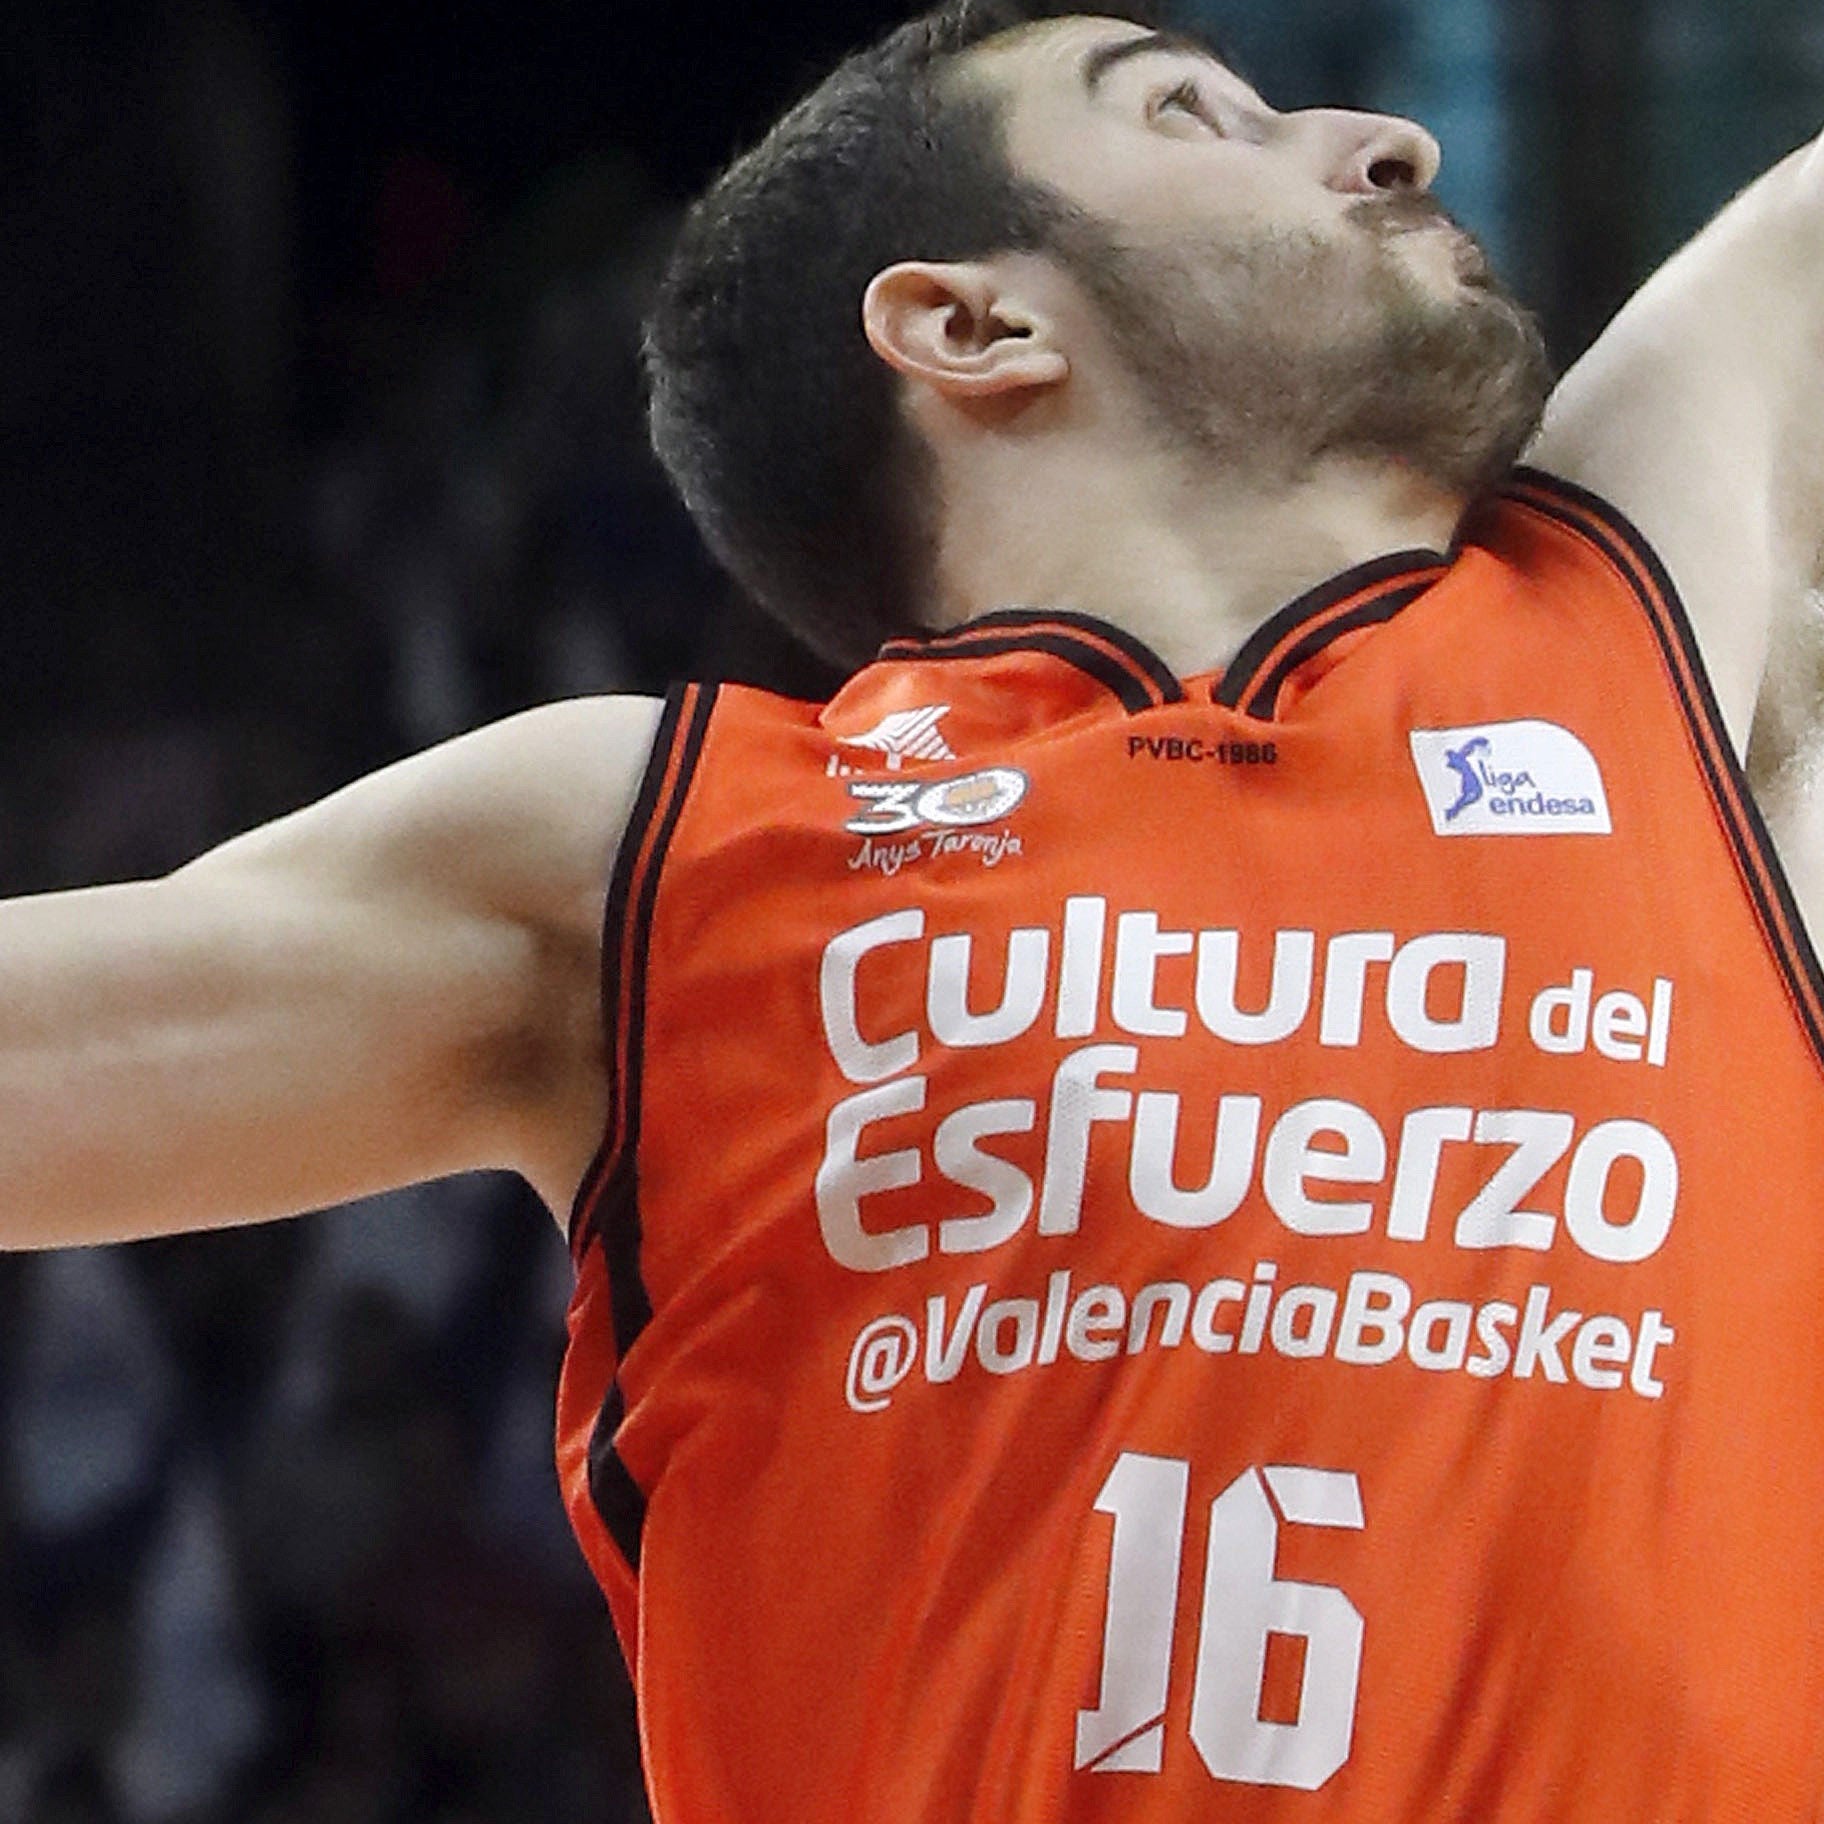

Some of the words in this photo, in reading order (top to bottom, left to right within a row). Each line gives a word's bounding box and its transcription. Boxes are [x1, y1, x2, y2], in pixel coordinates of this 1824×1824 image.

[848, 836, 922, 877] Anys
[920, 828, 1023, 868] Taronja
[1477, 758, 1535, 795] liga
[1488, 791, 1596, 816] endesa
[820, 896, 1506, 1083] Cultura
[1530, 968, 1674, 1067] del
[814, 1044, 1679, 1272] Esfuerzo
[842, 1262, 1677, 1414] @ValenciaBasket
[1074, 1451, 1366, 1792] 16
